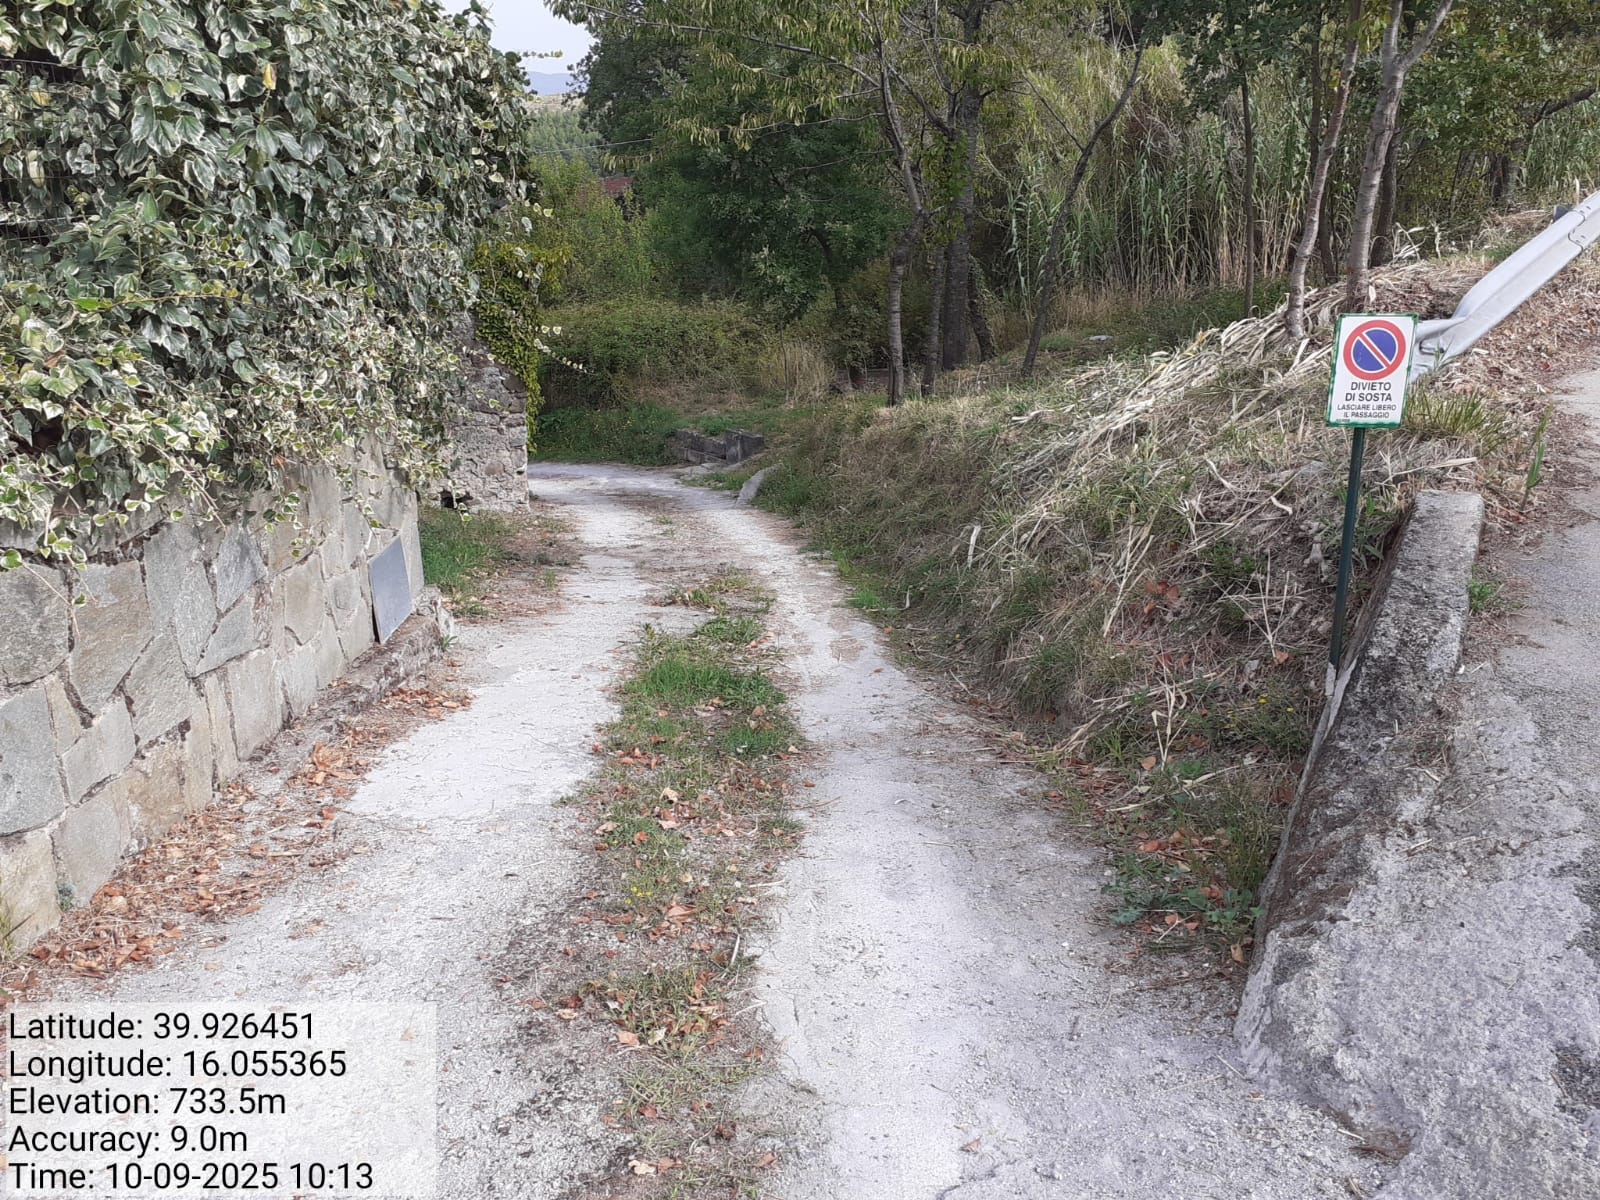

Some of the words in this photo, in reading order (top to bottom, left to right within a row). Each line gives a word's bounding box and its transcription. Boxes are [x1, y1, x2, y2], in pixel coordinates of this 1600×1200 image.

[1351, 382, 1391, 391] DIVIETO
[1346, 393, 1355, 401] DI
[1358, 393, 1392, 401] SOSTA
